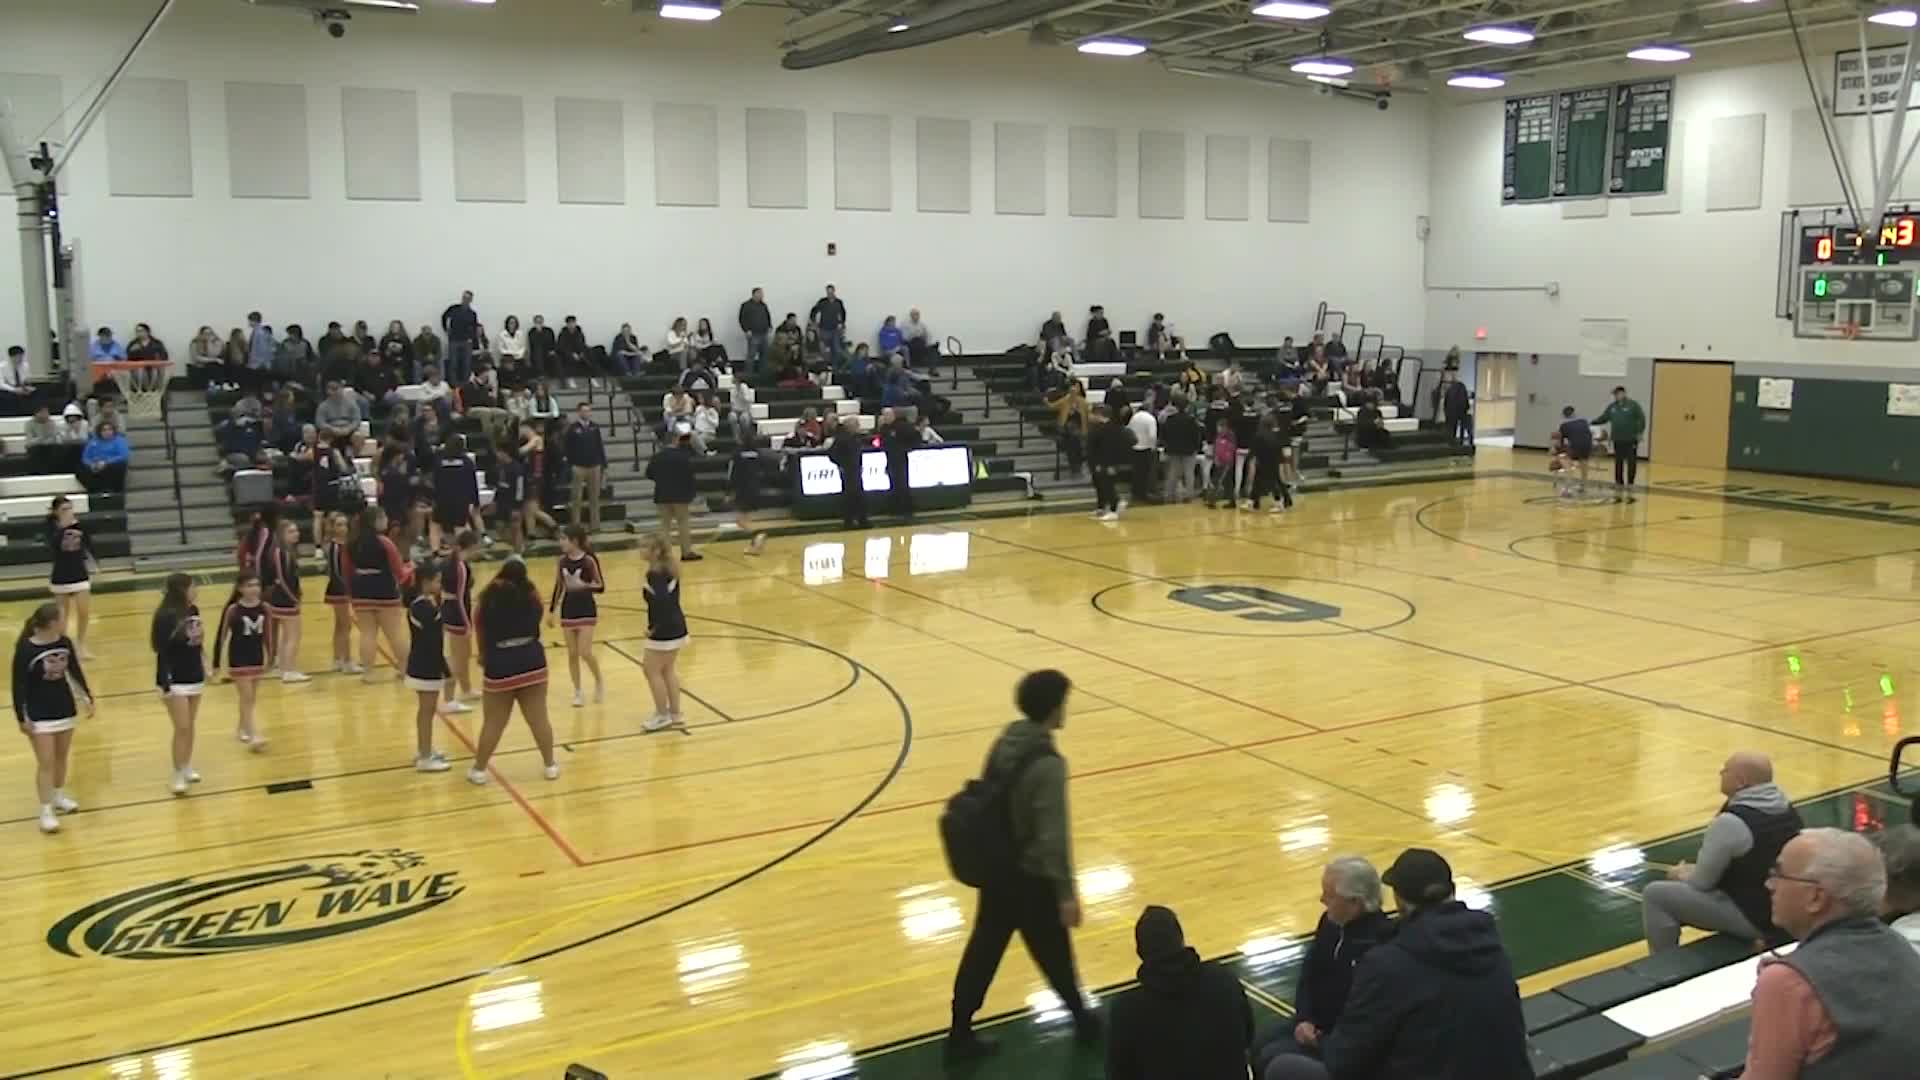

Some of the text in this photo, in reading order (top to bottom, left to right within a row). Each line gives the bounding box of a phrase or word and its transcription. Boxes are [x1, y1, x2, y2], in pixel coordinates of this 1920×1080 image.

[1814, 279, 1826, 297] 0
[242, 615, 264, 636] M
[102, 870, 460, 956] GREEN WAVE
